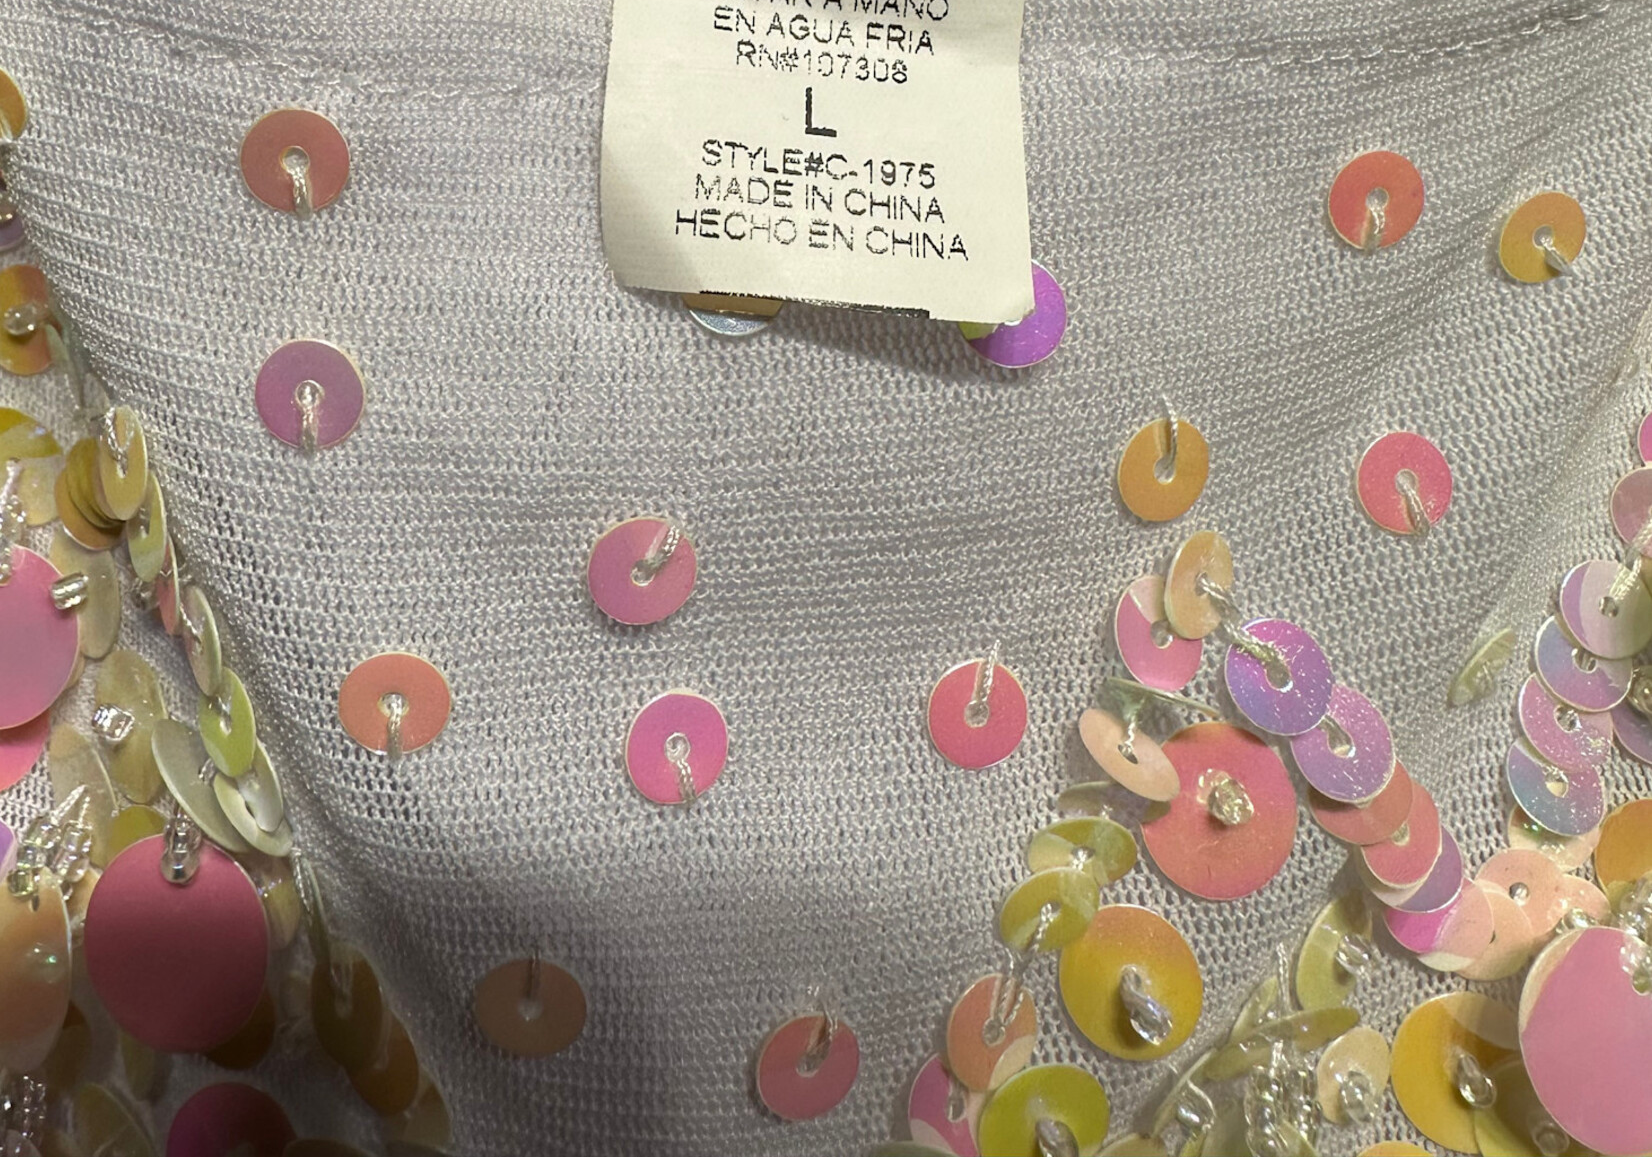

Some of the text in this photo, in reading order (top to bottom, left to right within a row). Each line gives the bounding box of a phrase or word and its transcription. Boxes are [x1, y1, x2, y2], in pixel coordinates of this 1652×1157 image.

[714, 5, 935, 56] EN AGUA FRIA
[805, 87, 837, 138] L
[702, 139, 936, 189] STYLE#C-1975
[695, 173, 945, 224] MADE IN CHINA
[675, 207, 969, 261] HECHO EN CHINA
